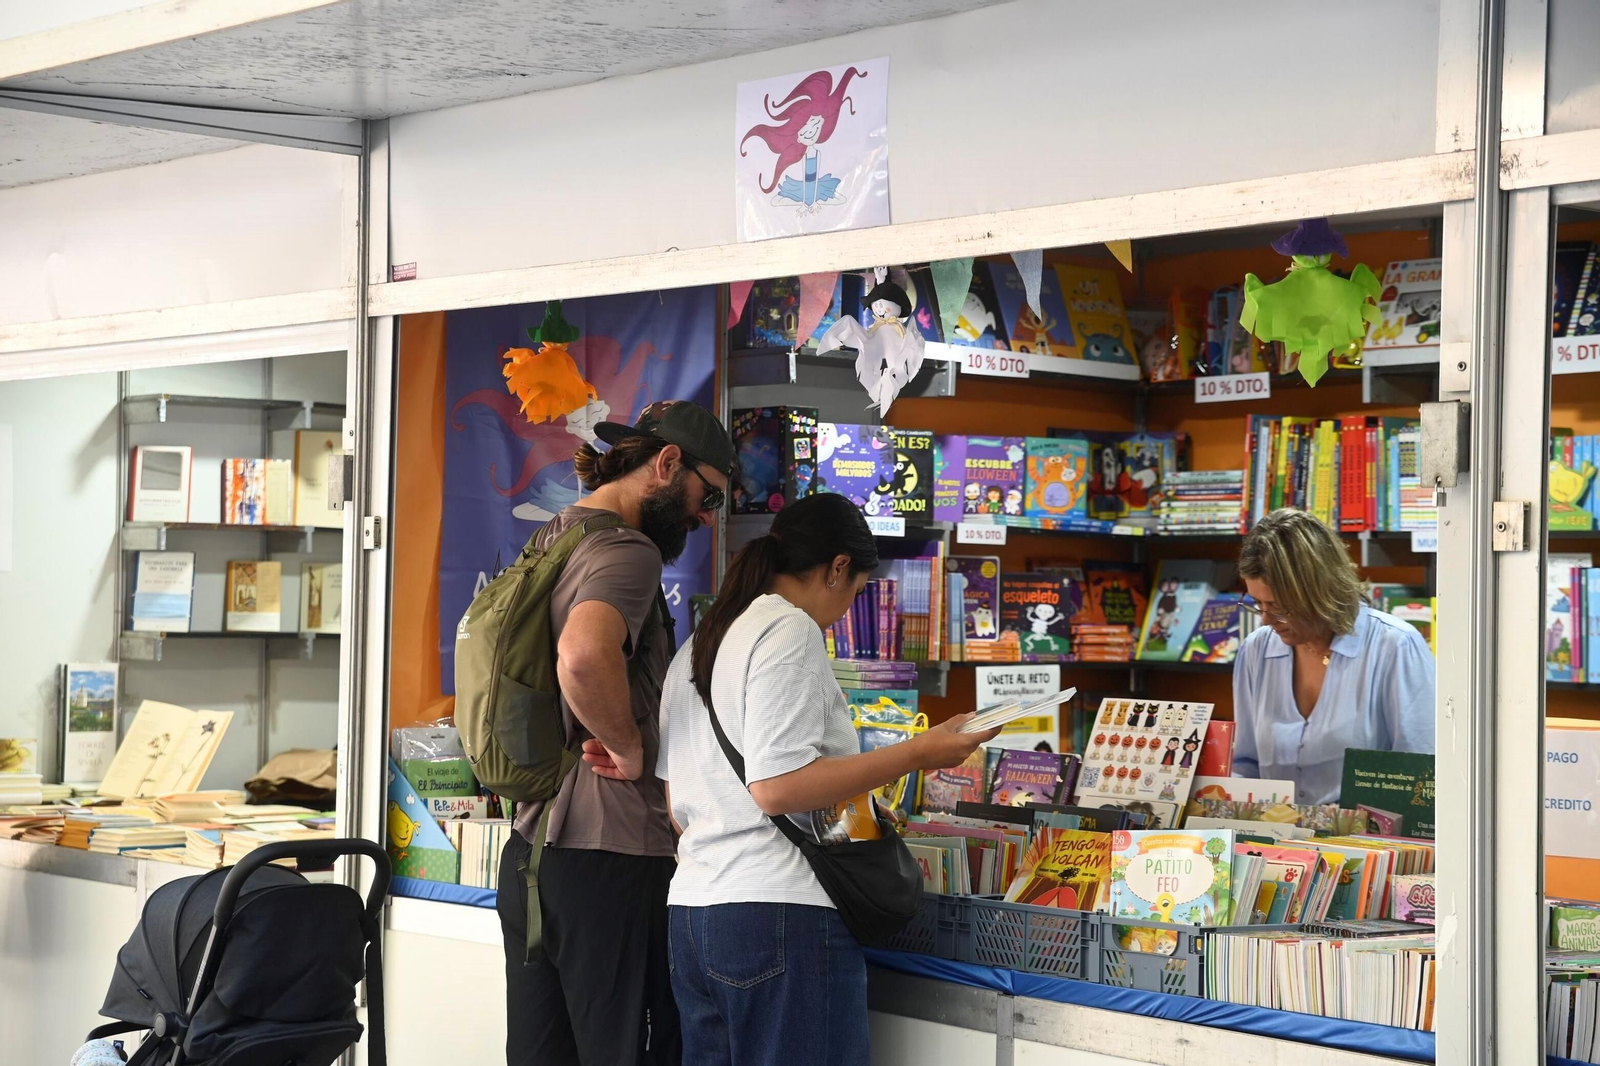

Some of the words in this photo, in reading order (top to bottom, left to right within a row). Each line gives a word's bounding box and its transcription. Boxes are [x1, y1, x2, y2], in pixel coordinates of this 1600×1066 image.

[1385, 273, 1402, 284] LA
[1557, 345, 1572, 361] %
[1577, 344, 1600, 360] DT
[968, 354, 983, 368] 10
[986, 357, 997, 370] %
[1000, 358, 1028, 374] DTO.
[1201, 381, 1216, 396] 10
[1220, 380, 1232, 395] %
[1235, 378, 1267, 394] DTO.
[908, 436, 931, 449] ES?
[965, 458, 1013, 470] ESCUBRE
[966, 468, 1017, 481] LLOWEEN
[892, 499, 926, 511] DADO!
[877, 522, 900, 532] IDEAS
[965, 530, 975, 539] 10
[976, 530, 983, 540] %
[985, 530, 1004, 541] DTO.
[1003, 590, 1060, 605] esqueleto
[987, 672, 1014, 685] ÚNETE
[1017, 673, 1027, 684] AL
[1029, 673, 1051, 684] RETO
[1547, 751, 1579, 764] PAGO
[427, 768, 433, 776] El
[434, 768, 450, 777] viaje
[450, 767, 459, 775] de
[1005, 770, 1054, 785] HALLOWEEN
[418, 780, 427, 791] El
[429, 780, 469, 792] Principito
[1079, 815, 1097, 829] SMA
[1055, 839, 1096, 854] TENGO
[1052, 850, 1106, 869] VOLCÁN
[1166, 849, 1174, 858] EL
[1145, 858, 1193, 875] PATITO
[1157, 876, 1179, 893] FEO
